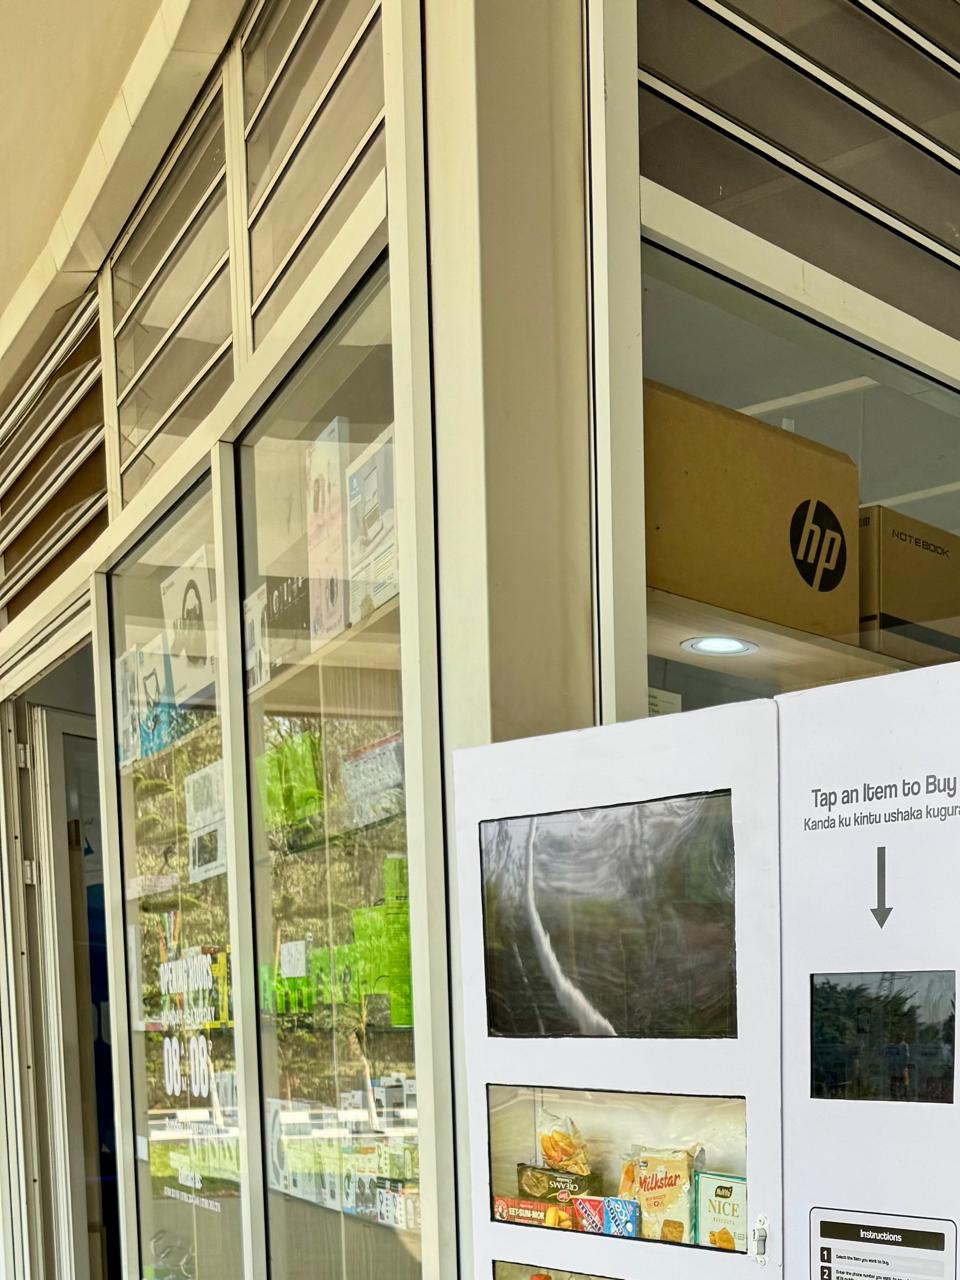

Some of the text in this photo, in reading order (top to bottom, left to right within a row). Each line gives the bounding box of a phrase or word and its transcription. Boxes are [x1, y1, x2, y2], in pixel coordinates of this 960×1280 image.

[794, 500, 844, 592] hp
[892, 529, 950, 558] NOTEBOOK
[812, 774, 957, 812] Tap an Item to Buy
[804, 816, 836, 831] Kanda
[838, 814, 852, 828] ku
[854, 811, 881, 827] kintu
[884, 806, 923, 824] ushaka
[163, 1036, 181, 1097] 08
[189, 1034, 209, 1098] 08
[639, 1171, 680, 1192] Milkstar
[708, 1198, 740, 1218] NICE
[860, 1229, 902, 1242] Instructions
[822, 1251, 828, 1260] 1
[823, 1270, 829, 1279] 2
